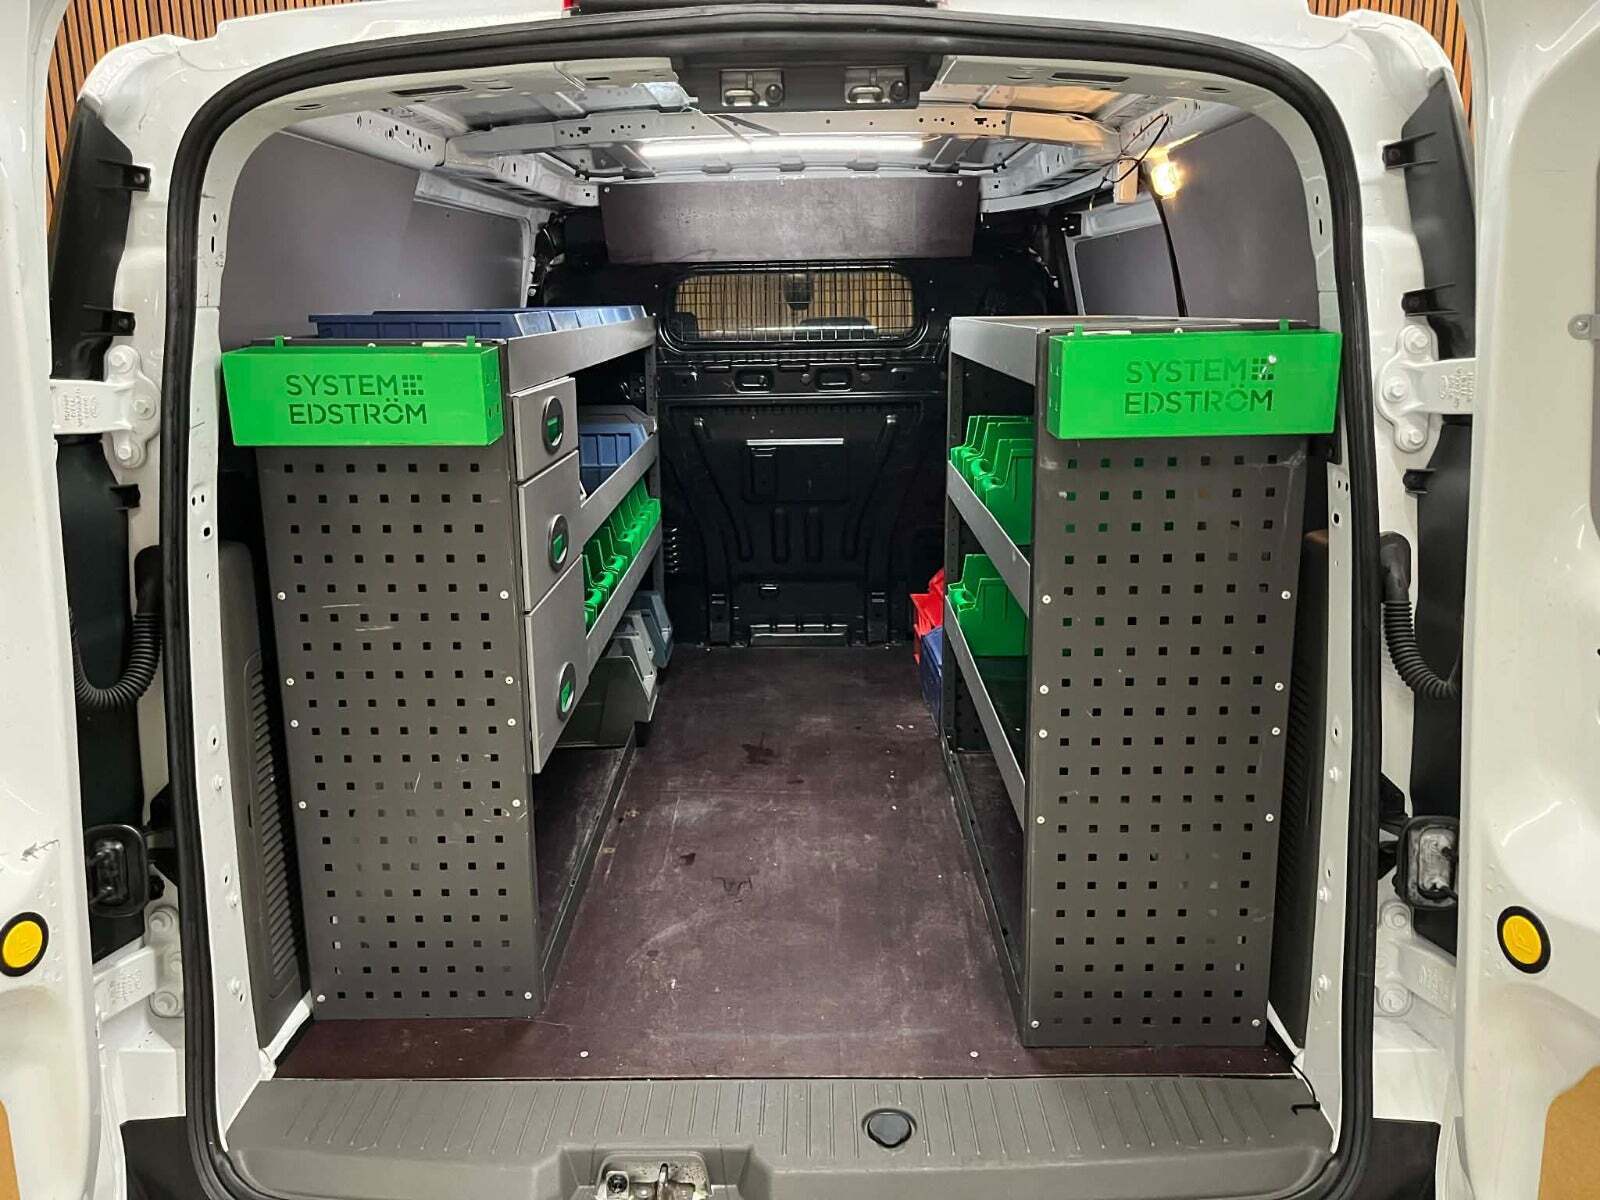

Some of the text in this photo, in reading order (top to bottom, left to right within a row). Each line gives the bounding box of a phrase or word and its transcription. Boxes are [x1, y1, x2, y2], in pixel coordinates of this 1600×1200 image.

[1126, 359, 1247, 383] SYSTEM
[286, 374, 398, 395] SYSTEM
[289, 398, 427, 424] EDSTRÖM
[1125, 384, 1273, 414] EDSTRÖM
